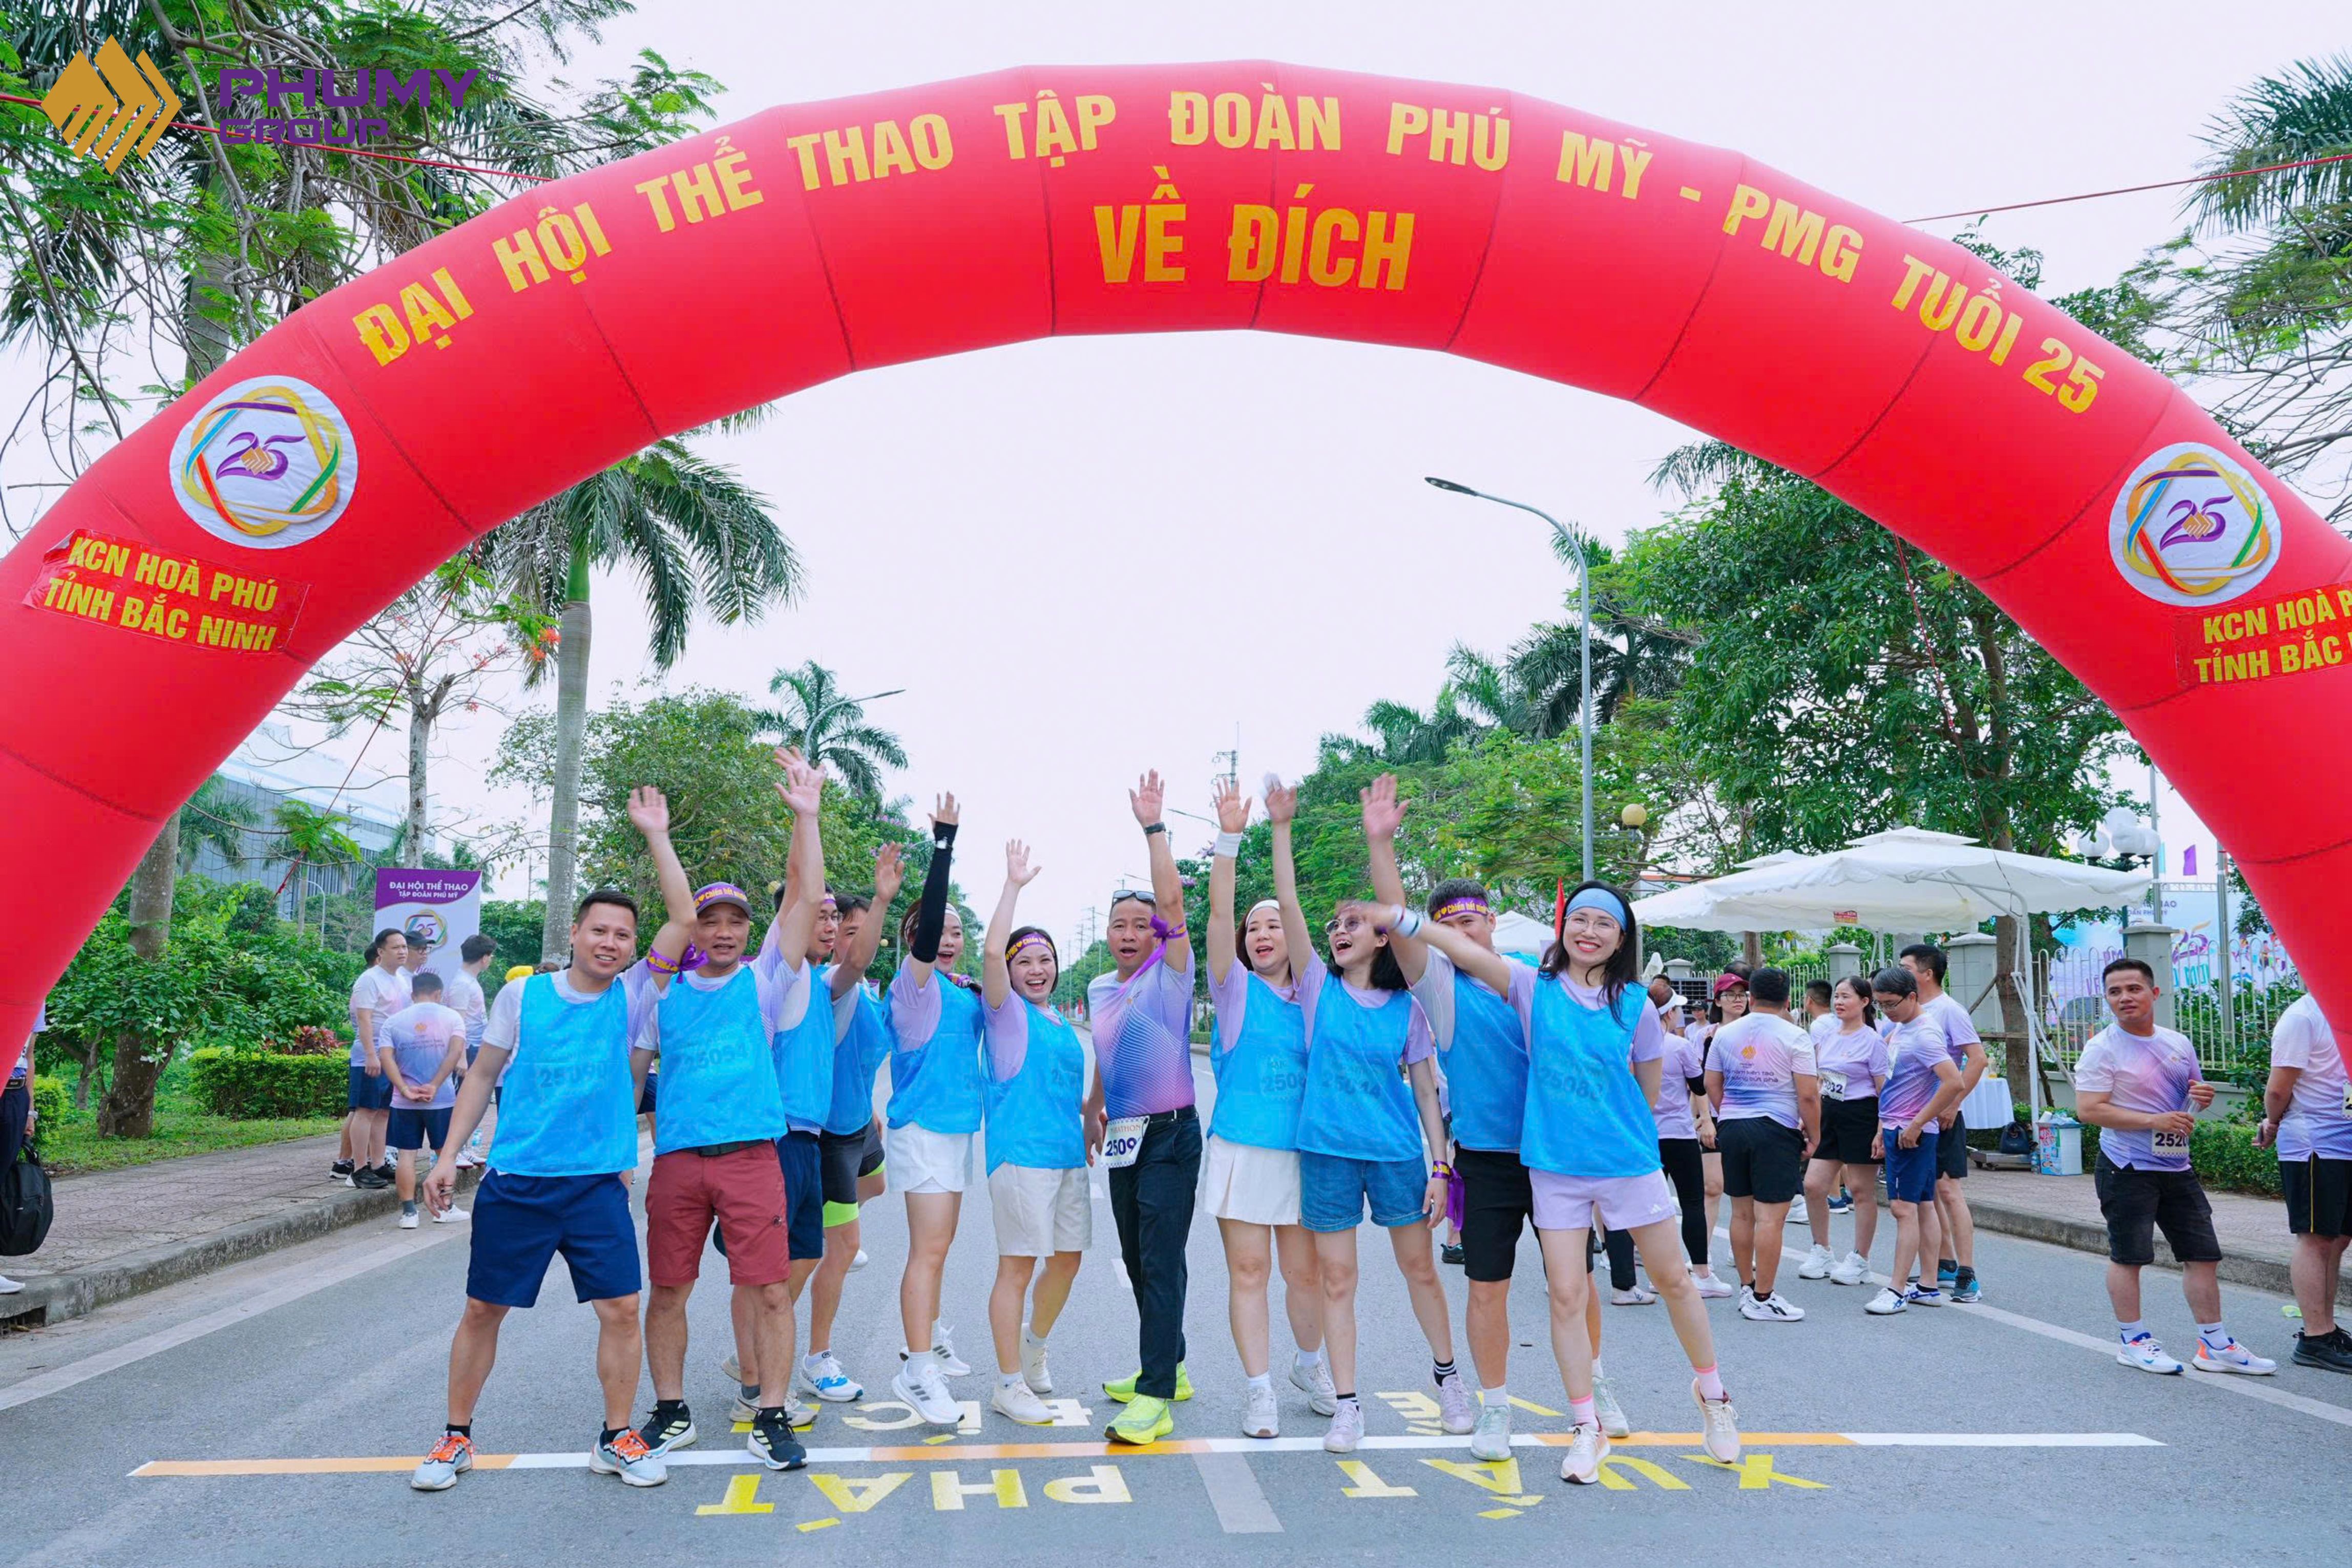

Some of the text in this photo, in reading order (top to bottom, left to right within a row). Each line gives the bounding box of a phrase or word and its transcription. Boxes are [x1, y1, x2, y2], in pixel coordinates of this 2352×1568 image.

[352, 267, 473, 367] ĐẠI
[492, 206, 612, 293] HỘI
[636, 136, 764, 233] THỂ
[787, 114, 953, 190] THAO
[993, 89, 1116, 167] TẬP
[1168, 82, 1341, 150] ĐOÀN
[1386, 102, 1510, 171] PHÚ
[1556, 130, 1653, 199] MỸ
[1722, 183, 1863, 283] PMG
[1891, 254, 2023, 366] TUỔI
[2022, 337, 2105, 413] 25
[1094, 165, 1414, 290] VỀ ĐÍCH
[216, 432, 306, 480] 25
[2160, 495, 2234, 552] 25
[67, 536, 278, 612] KCN HOÀ PHÚ
[43, 572, 277, 651] TỈNH BẮC NINH
[2203, 607, 2267, 644] KCN
[2276, 589, 2336, 630] HOÀ
[2194, 648, 2270, 683] TỈNH
[2280, 629, 2342, 673] BẮC
[389, 882, 405, 891] ĐẠI
[408, 881, 424, 891] HỘI
[427, 880, 442, 890] THỂ
[695, 1465, 1132, 1532] PHÁT
